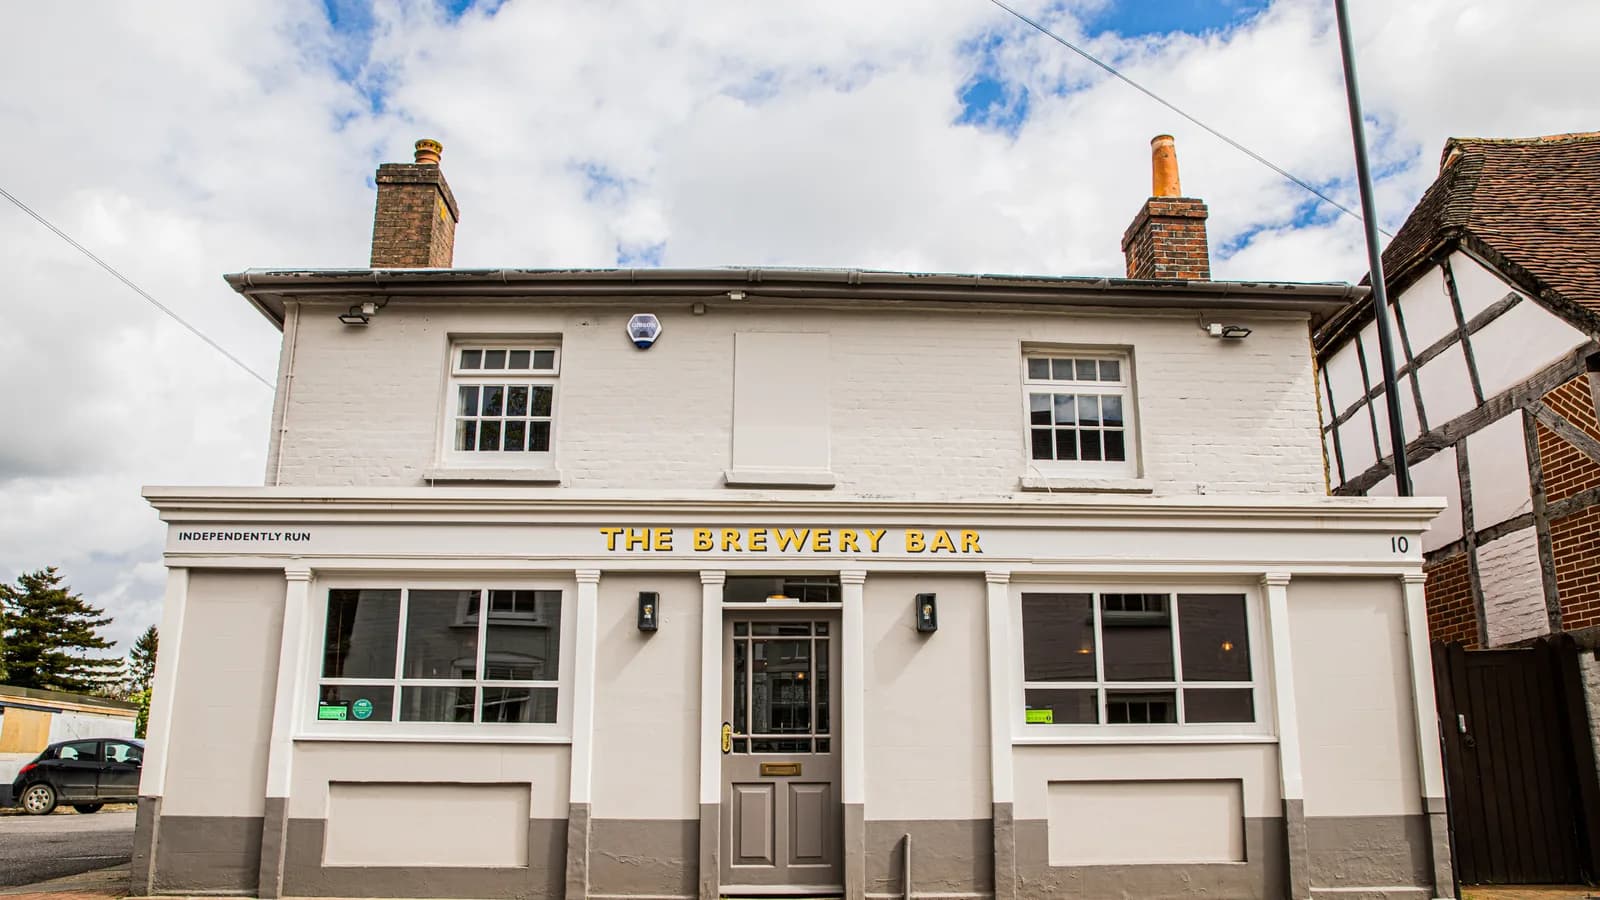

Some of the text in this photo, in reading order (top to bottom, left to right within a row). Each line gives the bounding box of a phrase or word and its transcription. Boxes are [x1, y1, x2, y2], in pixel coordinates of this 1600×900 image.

[179, 532, 311, 541] INDEPENDENTLY RUN
[600, 527, 984, 554] THE BREWERY BAR
[1391, 536, 1409, 554] 10
